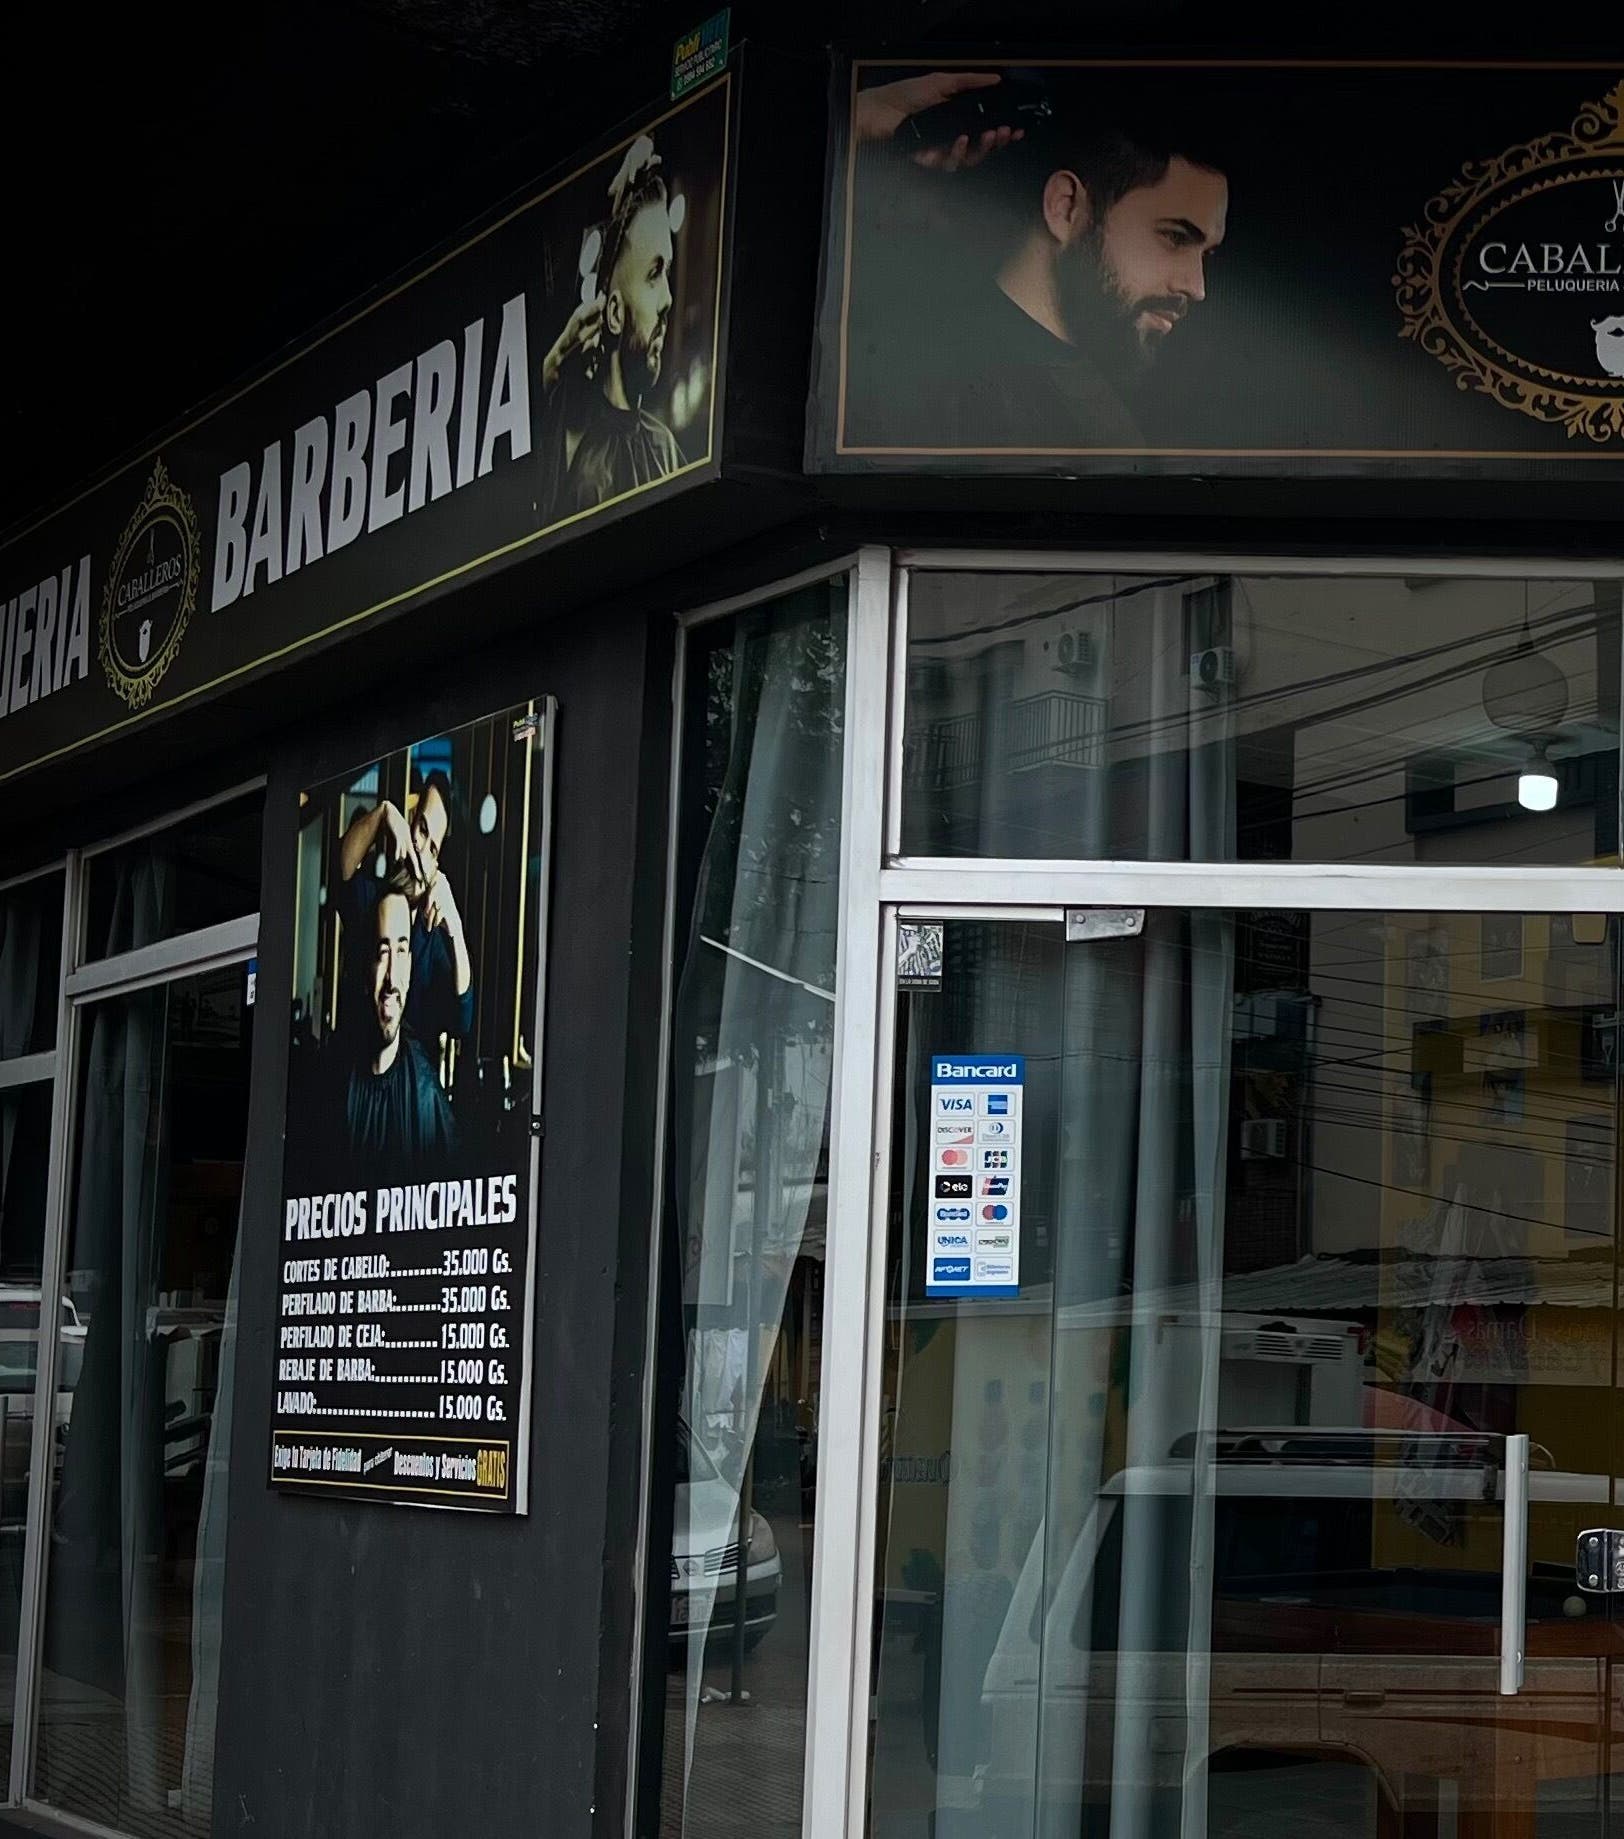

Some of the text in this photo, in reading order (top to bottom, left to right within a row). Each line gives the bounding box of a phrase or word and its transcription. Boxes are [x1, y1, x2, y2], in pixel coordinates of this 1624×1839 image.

[1527, 278, 1620, 293] PELUQUERIA
[211, 292, 532, 613] BARBERIA
[118, 553, 182, 607] CABALLEROS
[936, 1063, 1017, 1078] Bancard
[940, 1099, 972, 1110] VISA
[285, 1174, 517, 1241] PRECIOS PRINCIPALES
[283, 1259, 320, 1283] CORTES
[323, 1258, 338, 1281] DE
[492, 1248, 513, 1274] Gs.
[281, 1291, 336, 1316] PERFILADO
[339, 1291, 354, 1314] DE
[491, 1285, 511, 1310] Gs.
[280, 1325, 334, 1348] PERFILADO
[338, 1325, 352, 1347] DE
[441, 1323, 485, 1349] 15.000
[489, 1323, 510, 1348] Gs.
[278, 1358, 316, 1381] REBAJE
[319, 1358, 333, 1381] DE
[440, 1359, 483, 1385] 15.000
[488, 1359, 508, 1385] Gs.
[439, 1394, 482, 1420] 15.000
[486, 1395, 507, 1421] Gs.
[434, 1456, 441, 1481] y
[476, 1449, 506, 1489] GRATIS
